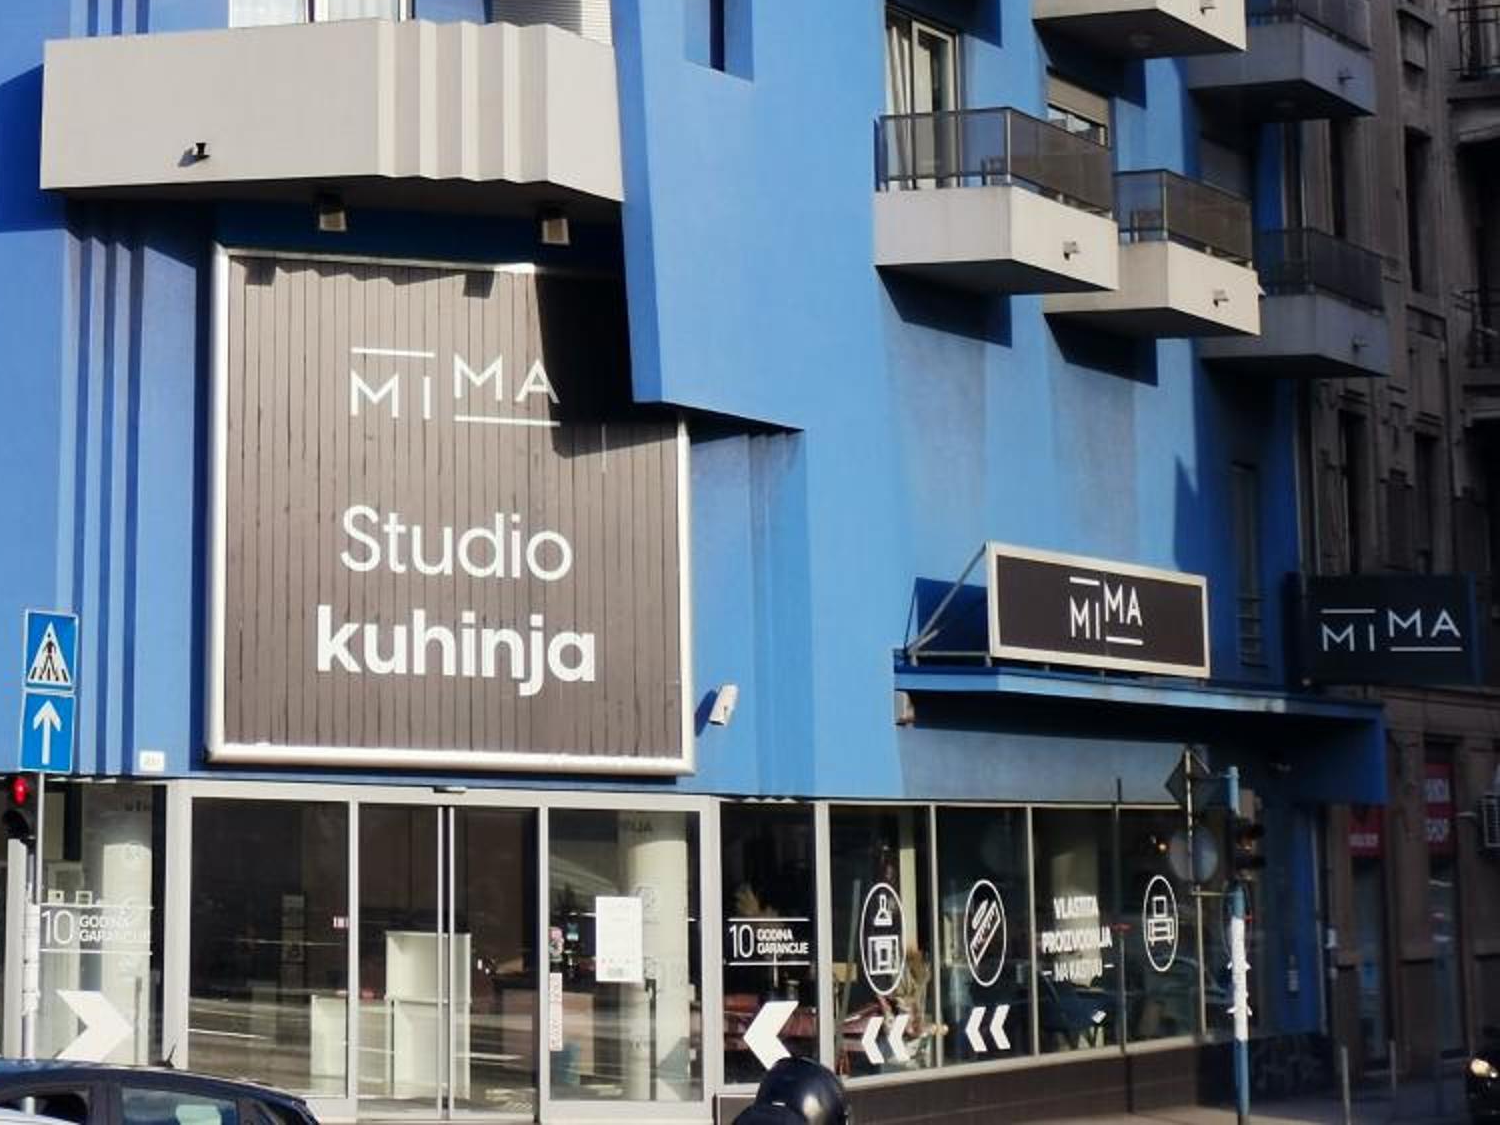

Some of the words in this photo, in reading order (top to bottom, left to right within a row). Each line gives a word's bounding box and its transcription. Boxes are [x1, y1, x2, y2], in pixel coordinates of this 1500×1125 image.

[348, 347, 562, 427] MIMA
[340, 505, 573, 582] Studio
[1069, 576, 1144, 645] MIMA
[1321, 608, 1463, 653] MIMA
[317, 604, 596, 696] kuhinja
[41, 909, 74, 944] 10
[729, 924, 754, 958] 10
[756, 928, 794, 942] GODINA
